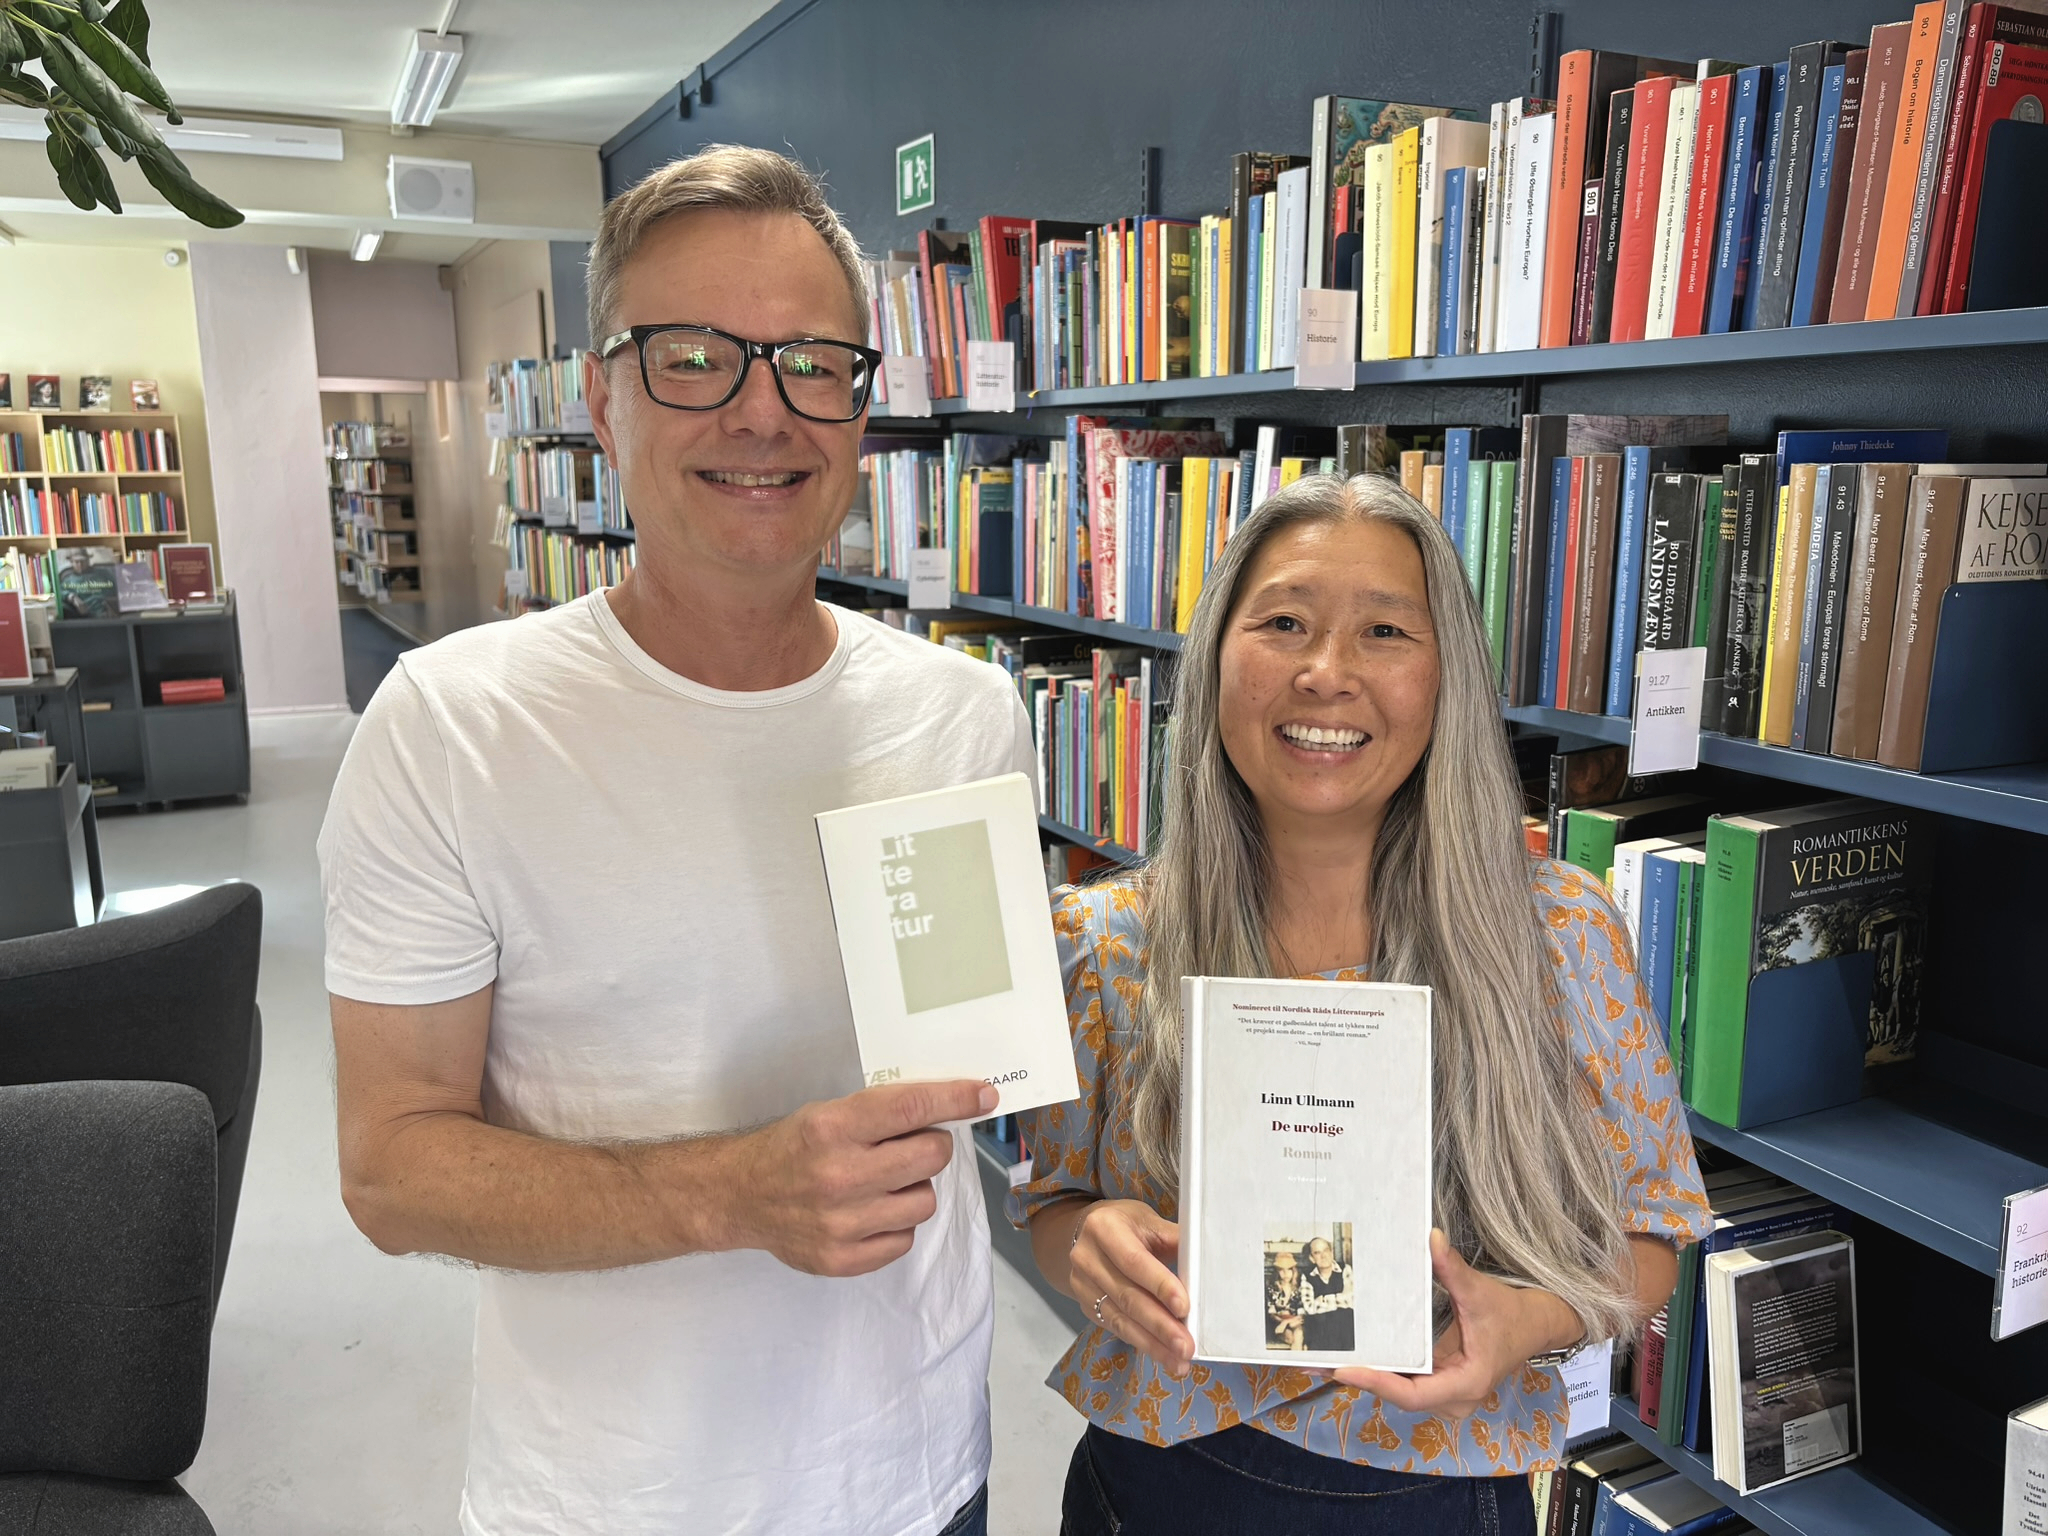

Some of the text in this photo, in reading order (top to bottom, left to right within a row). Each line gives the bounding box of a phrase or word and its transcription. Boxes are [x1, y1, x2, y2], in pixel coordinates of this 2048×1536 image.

[1919, 16, 1930, 37] 90.4
[1944, 12, 1956, 34] 90.7
[1997, 20, 2035, 37] SEBASTIAN
[1883, 46, 1892, 65] 90.12
[1987, 47, 2001, 85] 90.88
[1798, 64, 1808, 83] 90.1
[1958, 54, 1971, 88] Sebastian
[1742, 79, 1751, 97] 90.1
[1777, 74, 1785, 91] 90.1
[1831, 74, 1840, 91] 90.1
[1709, 88, 1718, 105] 90.1
[1902, 58, 1923, 145] Bogen om historie
[1619, 107, 1627, 124] 90.1
[1737, 115, 1746, 136] Bent
[1531, 133, 1538, 143] 90
[1704, 124, 1714, 151] Henrik
[1615, 143, 1624, 166] Yuval
[1733, 138, 1743, 161] Meier
[1818, 113, 1835, 188] Tom Phillips: Truth
[1529, 161, 1537, 177] Uffe
[1700, 153, 1710, 185] Jensen:
[1904, 57, 1949, 270] Danmarkshistorie mellem erindring og glemsel
[1613, 167, 1622, 188] Noah
[1697, 187, 1706, 210] Mens
[1772, 105, 1803, 276] Ryan North: Hvordan man opfinder alting
[1585, 191, 1596, 214] 90.1
[1727, 206, 1735, 218] De
[1696, 211, 1703, 219] vi
[1524, 218, 1532, 248] Hvorhen
[1608, 217, 1617, 240] Homo
[1692, 220, 1702, 247] venter
[1606, 241, 1615, 261] Deus
[1690, 248, 1700, 259] på
[1719, 219, 1734, 268] grænseløse
[1521, 250, 1531, 280] Europa?
[1687, 260, 1698, 293] miraklet
[1307, 308, 1318, 317] 90
[1307, 334, 1337, 343] Historie
[1831, 439, 1895, 453] Johnny Thiedecke
[1629, 456, 1637, 480] 91.246
[1798, 476, 1806, 492] 91.4
[1875, 475, 1886, 498] 91.47
[1744, 489, 1754, 512] PETER
[1835, 485, 1847, 510] 91.43
[1924, 489, 1936, 513] 91.47
[1977, 492, 2048, 534] KEJSE
[1741, 513, 1753, 545] ØRSTED
[1808, 515, 1823, 560] PAIDEIA
[1970, 543, 1996, 567] AF
[1858, 512, 1882, 641] Mary Beard: Emperor of Rome
[1906, 527, 1930, 643] Mary Beard: Kejser af Rom
[1968, 569, 2034, 579] OLDTIDENS ROMERSKE
[1659, 542, 1679, 640] BO LIDEGAARD
[1816, 530, 1842, 688] Makedonien Europas første stormagt
[1734, 619, 1743, 632] OG
[1730, 634, 1742, 675] FRANKRIG
[1648, 675, 1670, 686] 91.27
[1646, 705, 1685, 717] Antikken
[880, 833, 916, 861] Lit
[1793, 820, 1908, 855] ROMANTIKKENS
[1790, 840, 1906, 886] VERDEN
[881, 864, 913, 887] te
[1654, 867, 1662, 882] 91.7
[1790, 890, 1809, 900] Natur,
[1810, 884, 1837, 895] menneske,
[1838, 878, 1863, 890] samfund,
[1864, 876, 1879, 884] kunst
[1887, 872, 1903, 880] kultur
[885, 891, 918, 914] ra
[1651, 897, 1660, 923] Andrea
[891, 914, 934, 939] tur
[1232, 1003, 1271, 1011] Nomineret
[1282, 1006, 1311, 1014] Nordisk
[1313, 1006, 1331, 1015] Råds
[1333, 1008, 1385, 1018] Litteraturpris
[1345, 1022, 1365, 1031] lykkes
[1261, 1093, 1355, 1108] Linn Ullmann
[1272, 1120, 1344, 1137] De urolige
[1283, 1147, 1332, 1160] Roman
[2016, 1223, 2028, 1237] 92
[2012, 1267, 2047, 1288] historie
[2028, 1469, 2045, 1480] 94.41
[2026, 1482, 2046, 1494] Ulrich
[2029, 1491, 2041, 1499] von
[2024, 1495, 2046, 1508] Hassell
[2025, 1518, 2043, 1528] andet
[2028, 1511, 2040, 1520] Det
